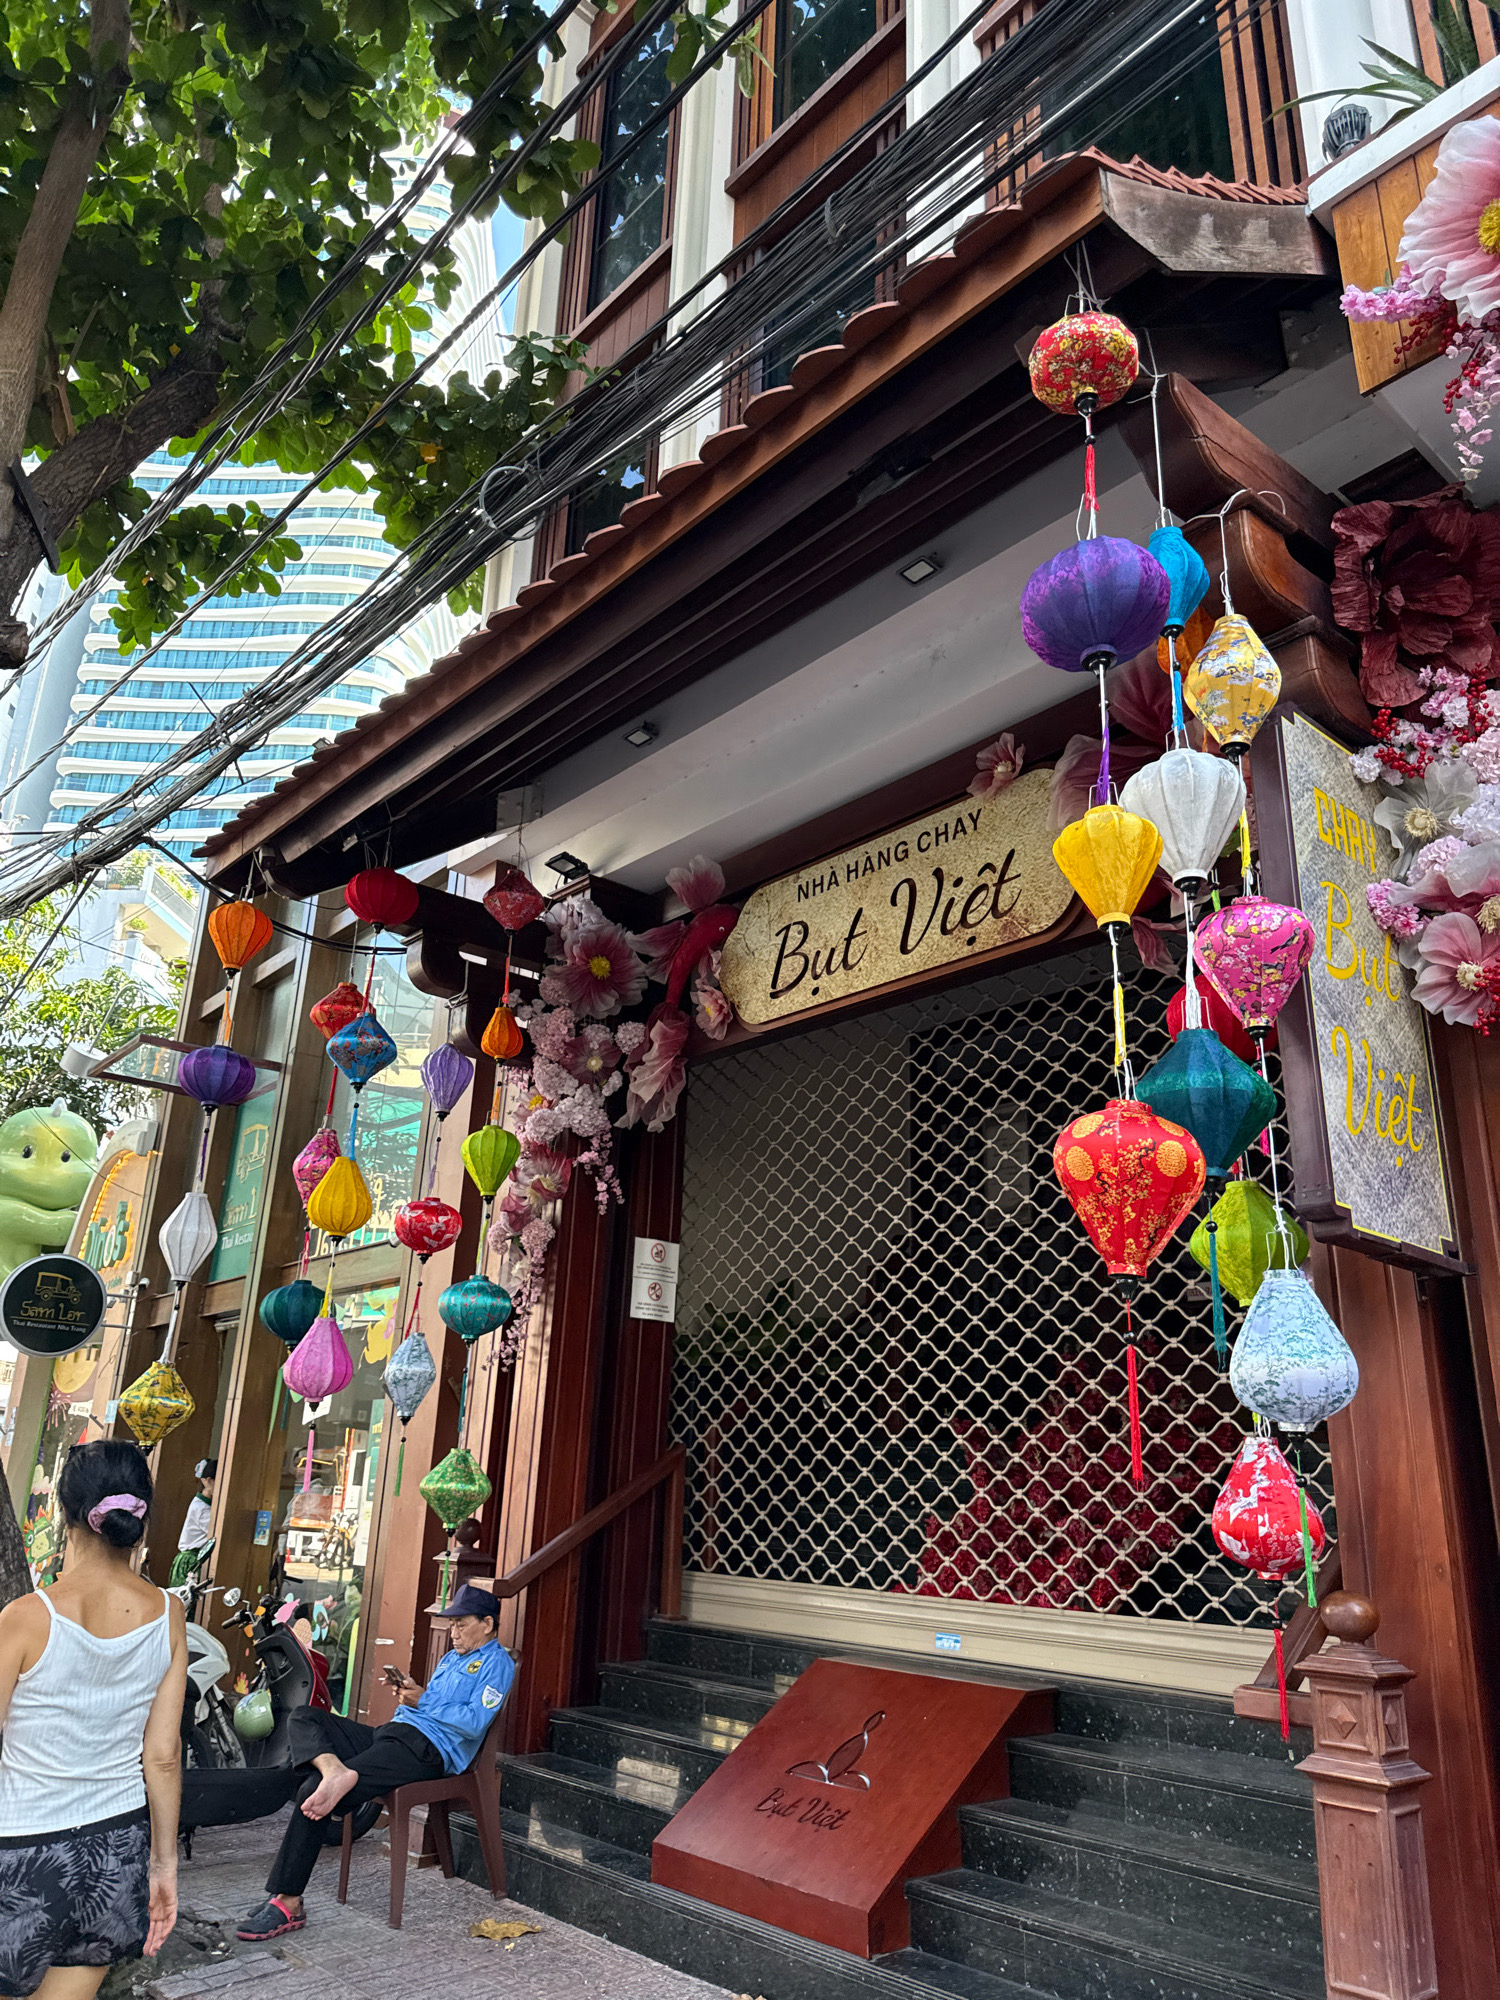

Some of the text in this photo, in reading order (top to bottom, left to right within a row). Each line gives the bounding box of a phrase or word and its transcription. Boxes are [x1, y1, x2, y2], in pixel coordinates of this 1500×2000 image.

[797, 808, 983, 903] NHÀ HÀNG CHAY
[1313, 786, 1376, 873] CHAY
[769, 848, 1022, 1000] Bụt Việt
[1319, 881, 1400, 1007] Bụt
[1331, 1025, 1424, 1167] Việt
[20, 1300, 55, 1318] Sam
